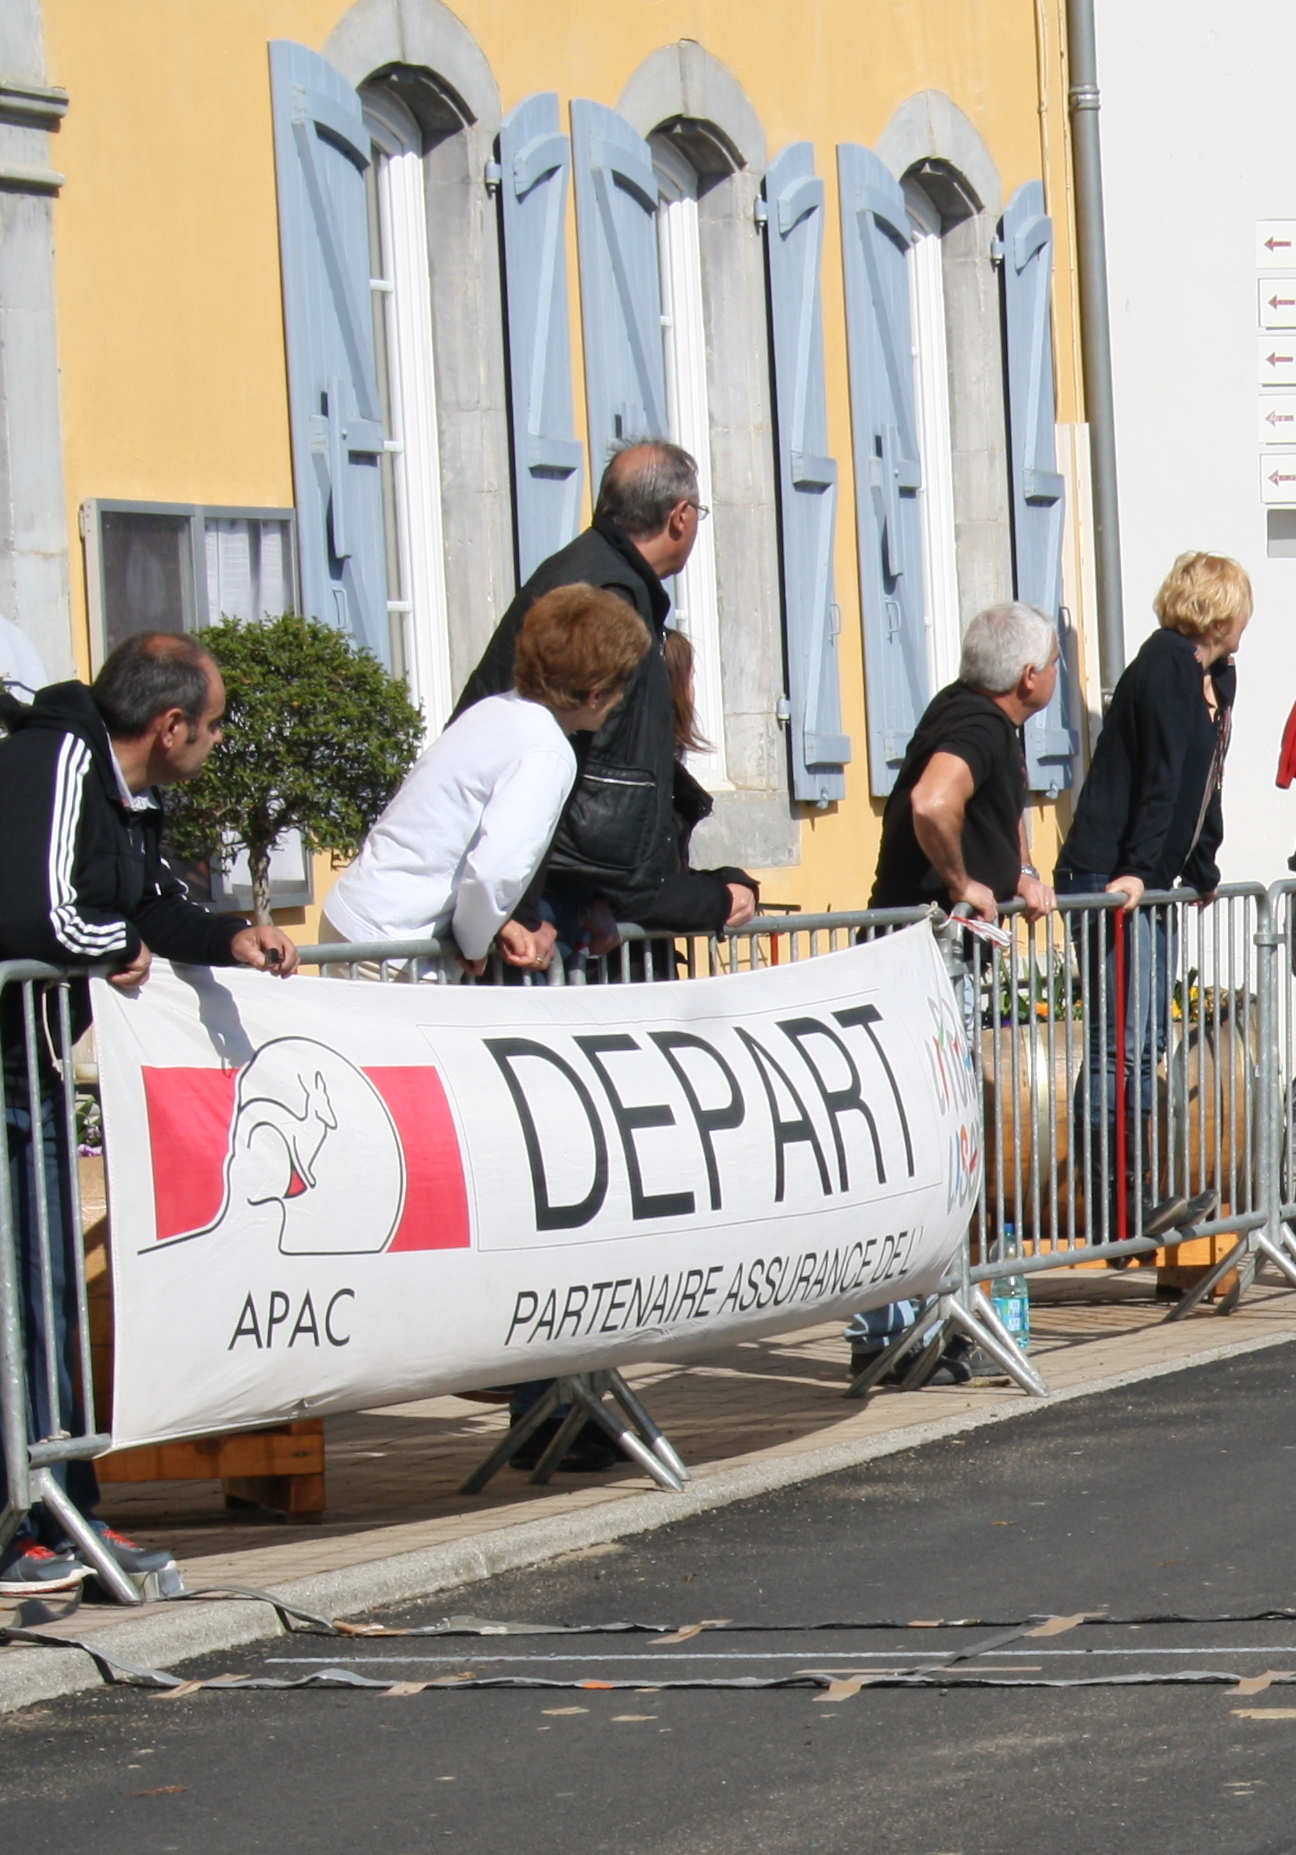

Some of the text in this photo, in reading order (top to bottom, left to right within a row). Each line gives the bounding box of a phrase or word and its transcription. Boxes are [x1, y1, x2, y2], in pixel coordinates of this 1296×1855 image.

[483, 1004, 915, 1231] DEPART
[229, 1289, 356, 1351] APAC
[505, 1265, 723, 1346] PARTENAIRE
[716, 1239, 878, 1314] ASSURANCE
[869, 1231, 908, 1284] DE
